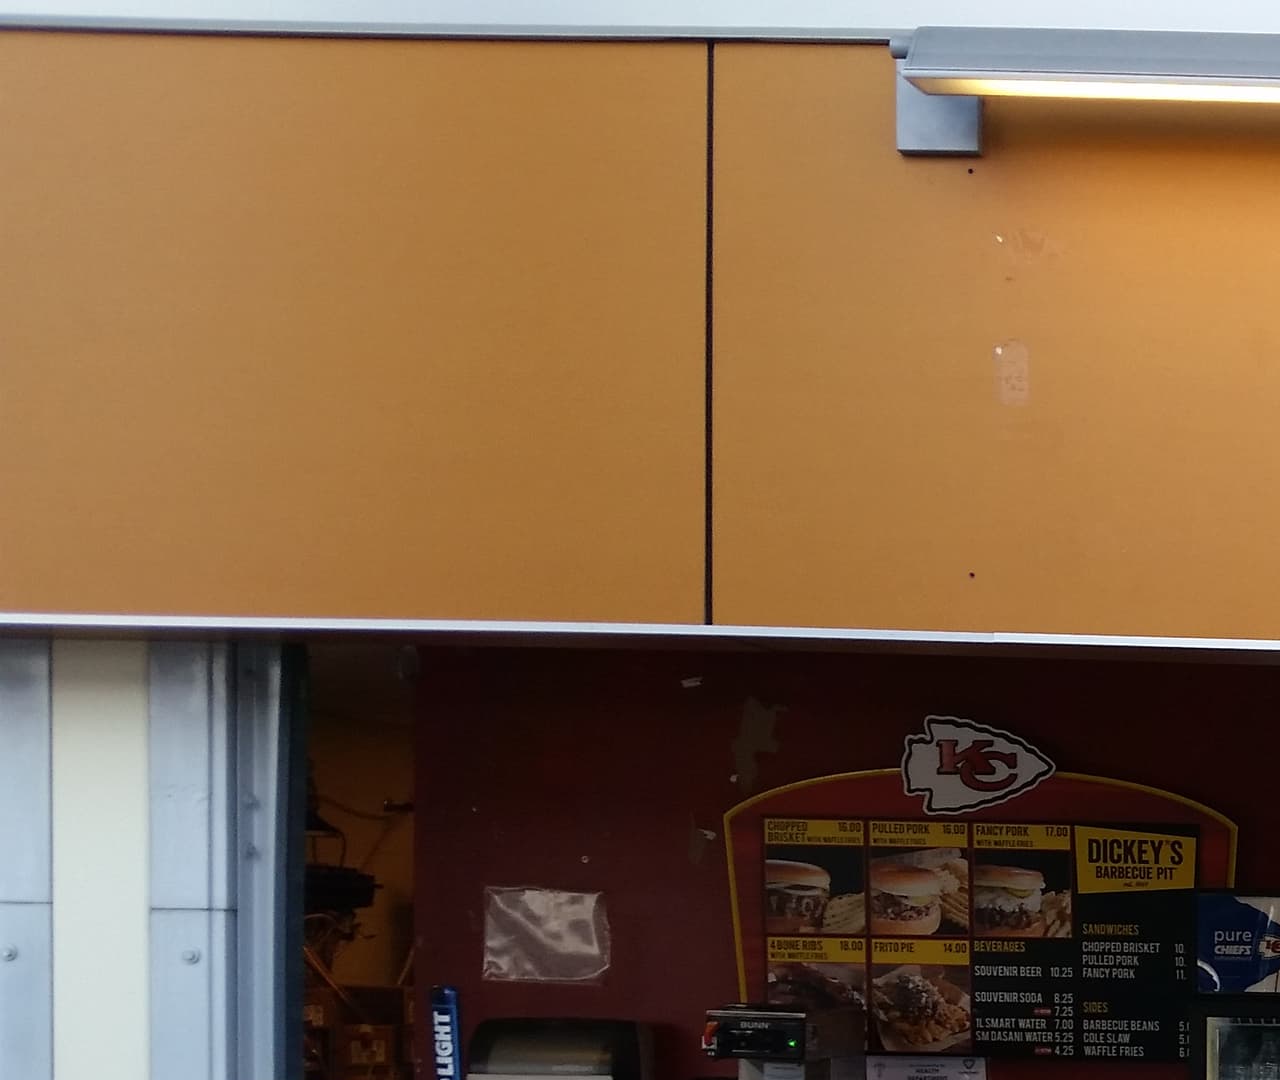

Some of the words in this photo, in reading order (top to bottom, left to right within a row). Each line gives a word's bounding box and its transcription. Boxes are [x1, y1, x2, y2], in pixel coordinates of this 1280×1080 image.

[767, 821, 808, 831] CHOPPED
[872, 823, 905, 834] PULLED
[907, 824, 930, 834] PORK
[976, 825, 1004, 836] FANCY
[1006, 826, 1029, 837] PORK
[1045, 826, 1068, 837] 17.00
[767, 832, 805, 842] BRISKET
[1088, 838, 1183, 865] DICKEY'S
[1095, 866, 1153, 880] BARBECUE
[1157, 867, 1175, 880] PIT
[1082, 923, 1139, 936] SANDWICHES
[1214, 929, 1252, 943] pure
[801, 941, 823, 951] RIBS
[874, 942, 899, 952] FRITO
[901, 943, 914, 953] PIE
[943, 943, 967, 953] 14.00
[974, 941, 1026, 952] BEVERAGES
[1082, 941, 1122, 953] CHOPPED
[1123, 942, 1160, 953] BRISKET
[1214, 946, 1252, 956] CHIEFS
[1082, 954, 1114, 966] PULLED
[1115, 955, 1139, 966] PORK
[974, 966, 1018, 977] SOUVENIR
[1020, 967, 1042, 977] BEER
[1050, 967, 1073, 978] 10.25
[1082, 967, 1109, 979] FANCY
[1111, 968, 1135, 979] PORK
[975, 992, 1018, 1003] SOUVENIR
[1019, 993, 1043, 1004] SODA
[1054, 993, 1073, 1003] 8.25
[1054, 1006, 1074, 1017] 7.25
[1082, 1002, 1109, 1014] SIDES
[740, 1021, 769, 1029] BUNN
[986, 1018, 1016, 1029] SMART
[1018, 1019, 1047, 1029] WATER
[1055, 1019, 1074, 1030] 7.00
[1083, 1020, 1130, 1031] BARBECUE
[1131, 1020, 1160, 1031] BEANS
[433, 1011, 455, 1075] LIGHT
[975, 1031, 990, 1042] SM
[991, 1032, 1023, 1042] DASANI
[1025, 1032, 1053, 1043] WATER
[1055, 1032, 1074, 1043] 5.25
[1083, 1033, 1106, 1043] COLE
[1108, 1033, 1131, 1044] SLAW
[1055, 1045, 1074, 1056] 4.25
[1083, 1046, 1115, 1056] WAFFLE
[1117, 1046, 1144, 1057] FRIES
